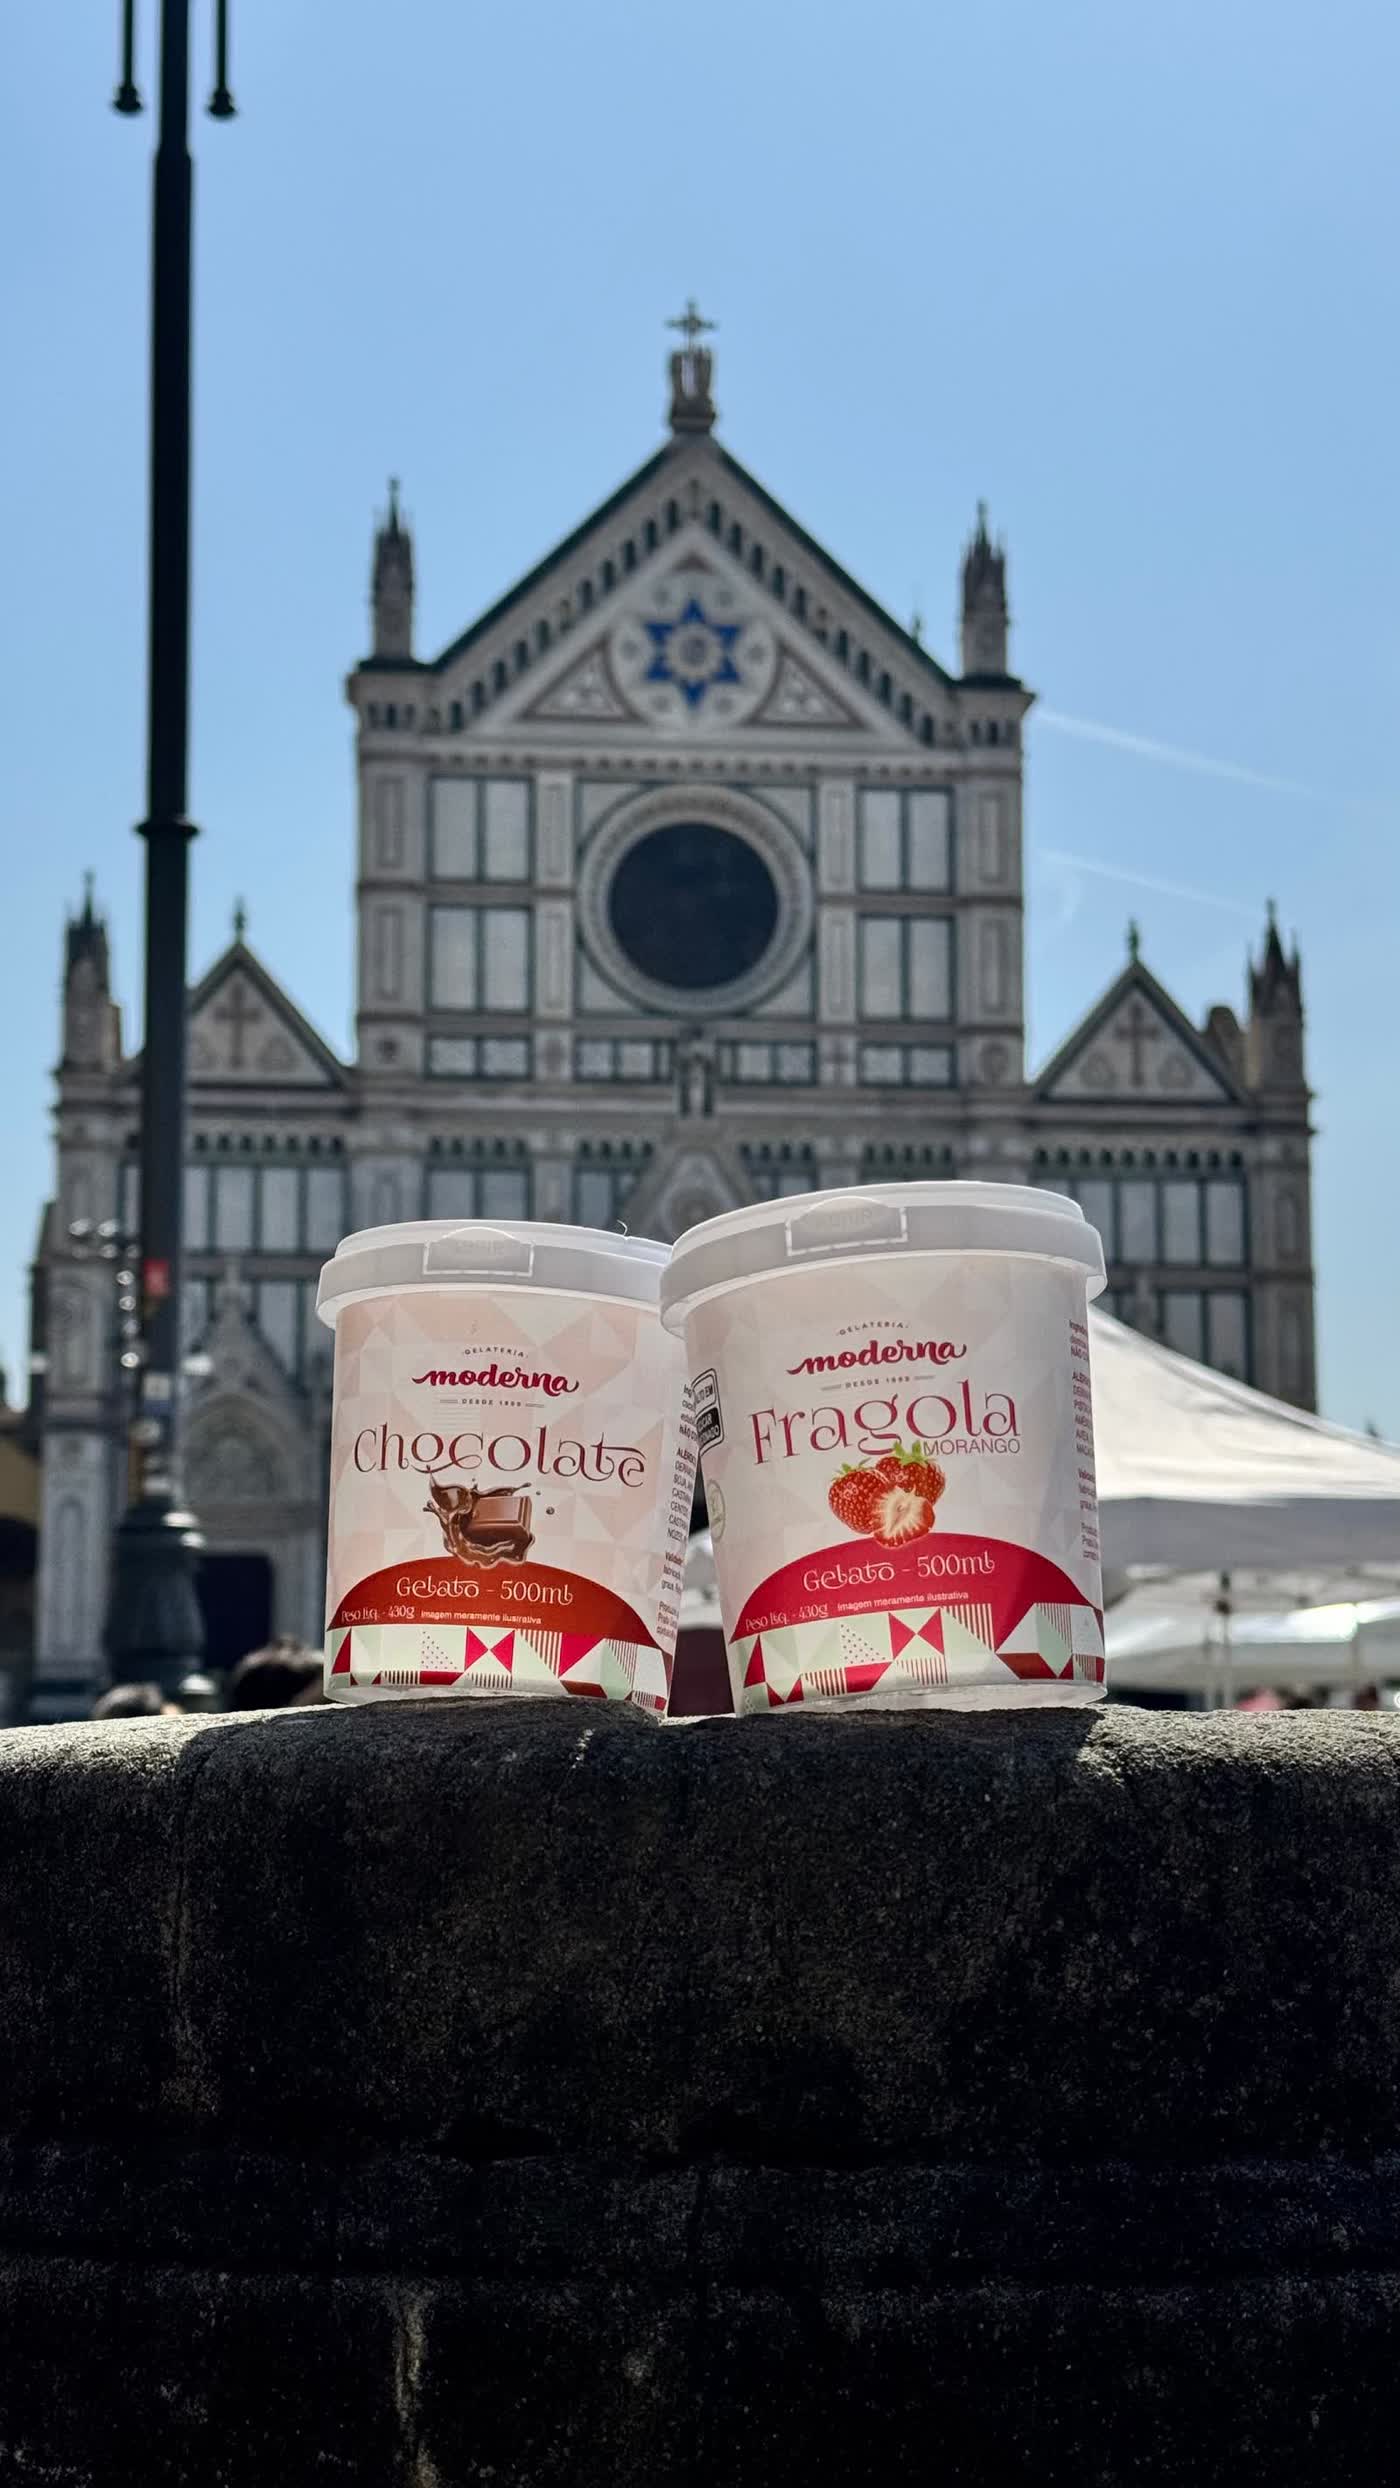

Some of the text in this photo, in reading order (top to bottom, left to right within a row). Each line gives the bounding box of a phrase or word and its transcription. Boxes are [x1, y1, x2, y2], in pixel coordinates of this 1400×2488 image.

[839, 1321, 904, 1336] GELATERIA
[464, 1346, 525, 1358] GELATERIA
[786, 1339, 967, 1376] moderna
[411, 1363, 580, 1397] moderna
[845, 1378, 879, 1389] DESDE
[461, 1398, 494, 1406] DESDE
[748, 1378, 1021, 1465] Fragola
[354, 1421, 646, 1488] Chocolate
[922, 1438, 1021, 1456] MORANGO
[803, 1562, 895, 1591] Gelato
[917, 1550, 995, 1577] 500ml
[396, 1576, 480, 1598] Gelato
[500, 1580, 573, 1605] 500ml
[874, 1594, 925, 1608] meramente
[388, 1605, 415, 1620] 430g
[454, 1612, 500, 1622] meramente
[799, 1603, 829, 1619] 430g
